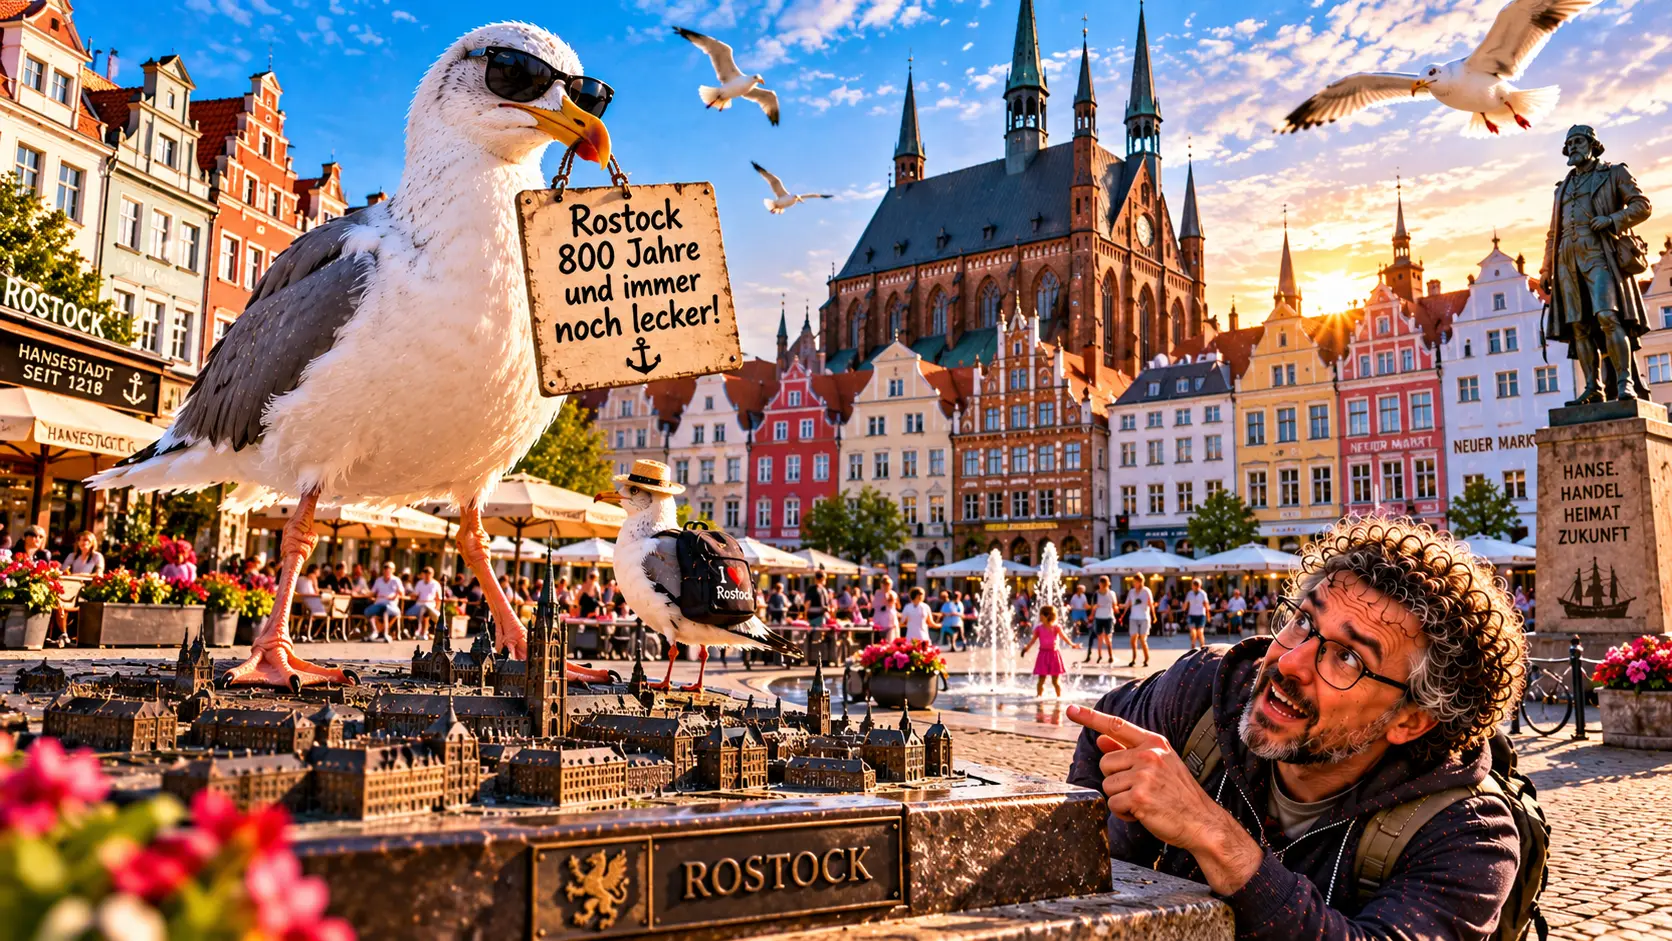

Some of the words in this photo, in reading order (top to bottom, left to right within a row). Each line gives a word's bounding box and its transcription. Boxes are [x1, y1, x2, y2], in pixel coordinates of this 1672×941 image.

[569, 198, 683, 237] Rostock
[558, 240, 615, 275] 800
[626, 235, 701, 268] Jahre
[565, 274, 613, 306] und
[623, 273, 701, 300] immer
[4, 277, 105, 338] ROSTOCK
[555, 306, 623, 343] noch
[632, 294, 720, 334] lecker!
[19, 344, 114, 381] HANSESTADT
[23, 364, 62, 386] SEIT
[1453, 437, 1493, 454] NEUER
[1563, 461, 1619, 481] HANSE.
[1561, 484, 1623, 502] HANDEL
[1564, 505, 1621, 523] HEIMAT
[1558, 526, 1631, 545] ZUKUNFT
[718, 566, 727, 583] I
[683, 846, 874, 900] ROSTOCK
